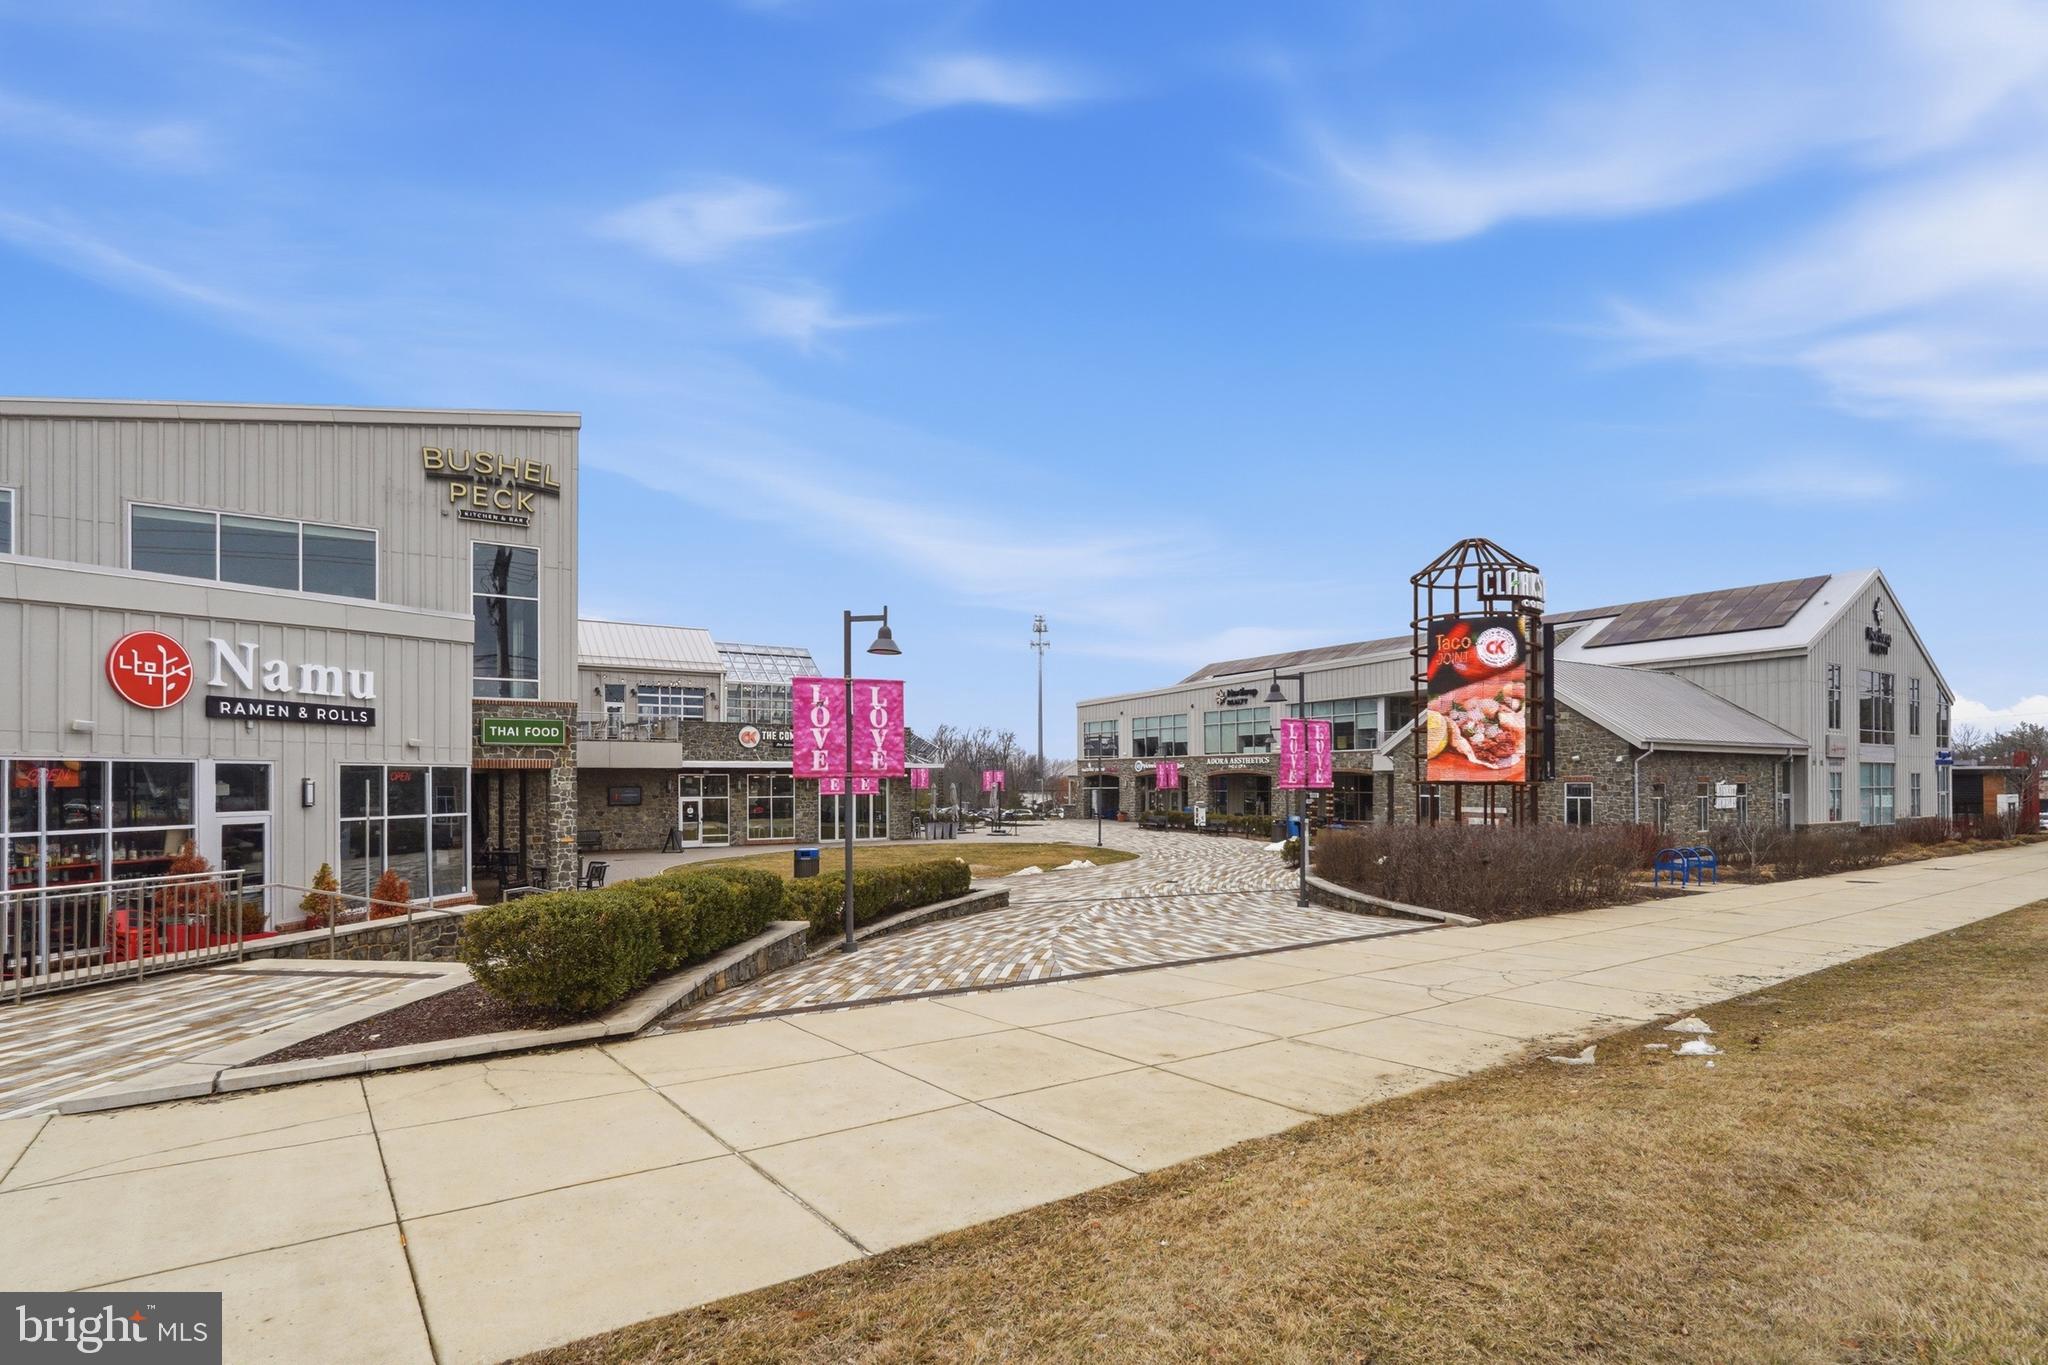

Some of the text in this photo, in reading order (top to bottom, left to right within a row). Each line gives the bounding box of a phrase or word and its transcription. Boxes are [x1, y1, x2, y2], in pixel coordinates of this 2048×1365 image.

[422, 446, 560, 488] BUSHEL
[449, 482, 535, 513] PECK
[464, 511, 498, 521] KITCHEN
[509, 516, 524, 524] BAR
[1435, 634, 1472, 651] Taco
[1486, 640, 1505, 655] CK
[207, 637, 377, 700] Namu
[1436, 652, 1468, 665] JOINT
[219, 702, 369, 723] RAMEN & ROLLS
[489, 726, 560, 737] THAI FOOD
[762, 731, 777, 740] THE
[810, 684, 830, 771] LOVE
[869, 686, 888, 771] LOVE
[1287, 723, 1298, 784] LOVE
[1314, 725, 1325, 784] LOVE
